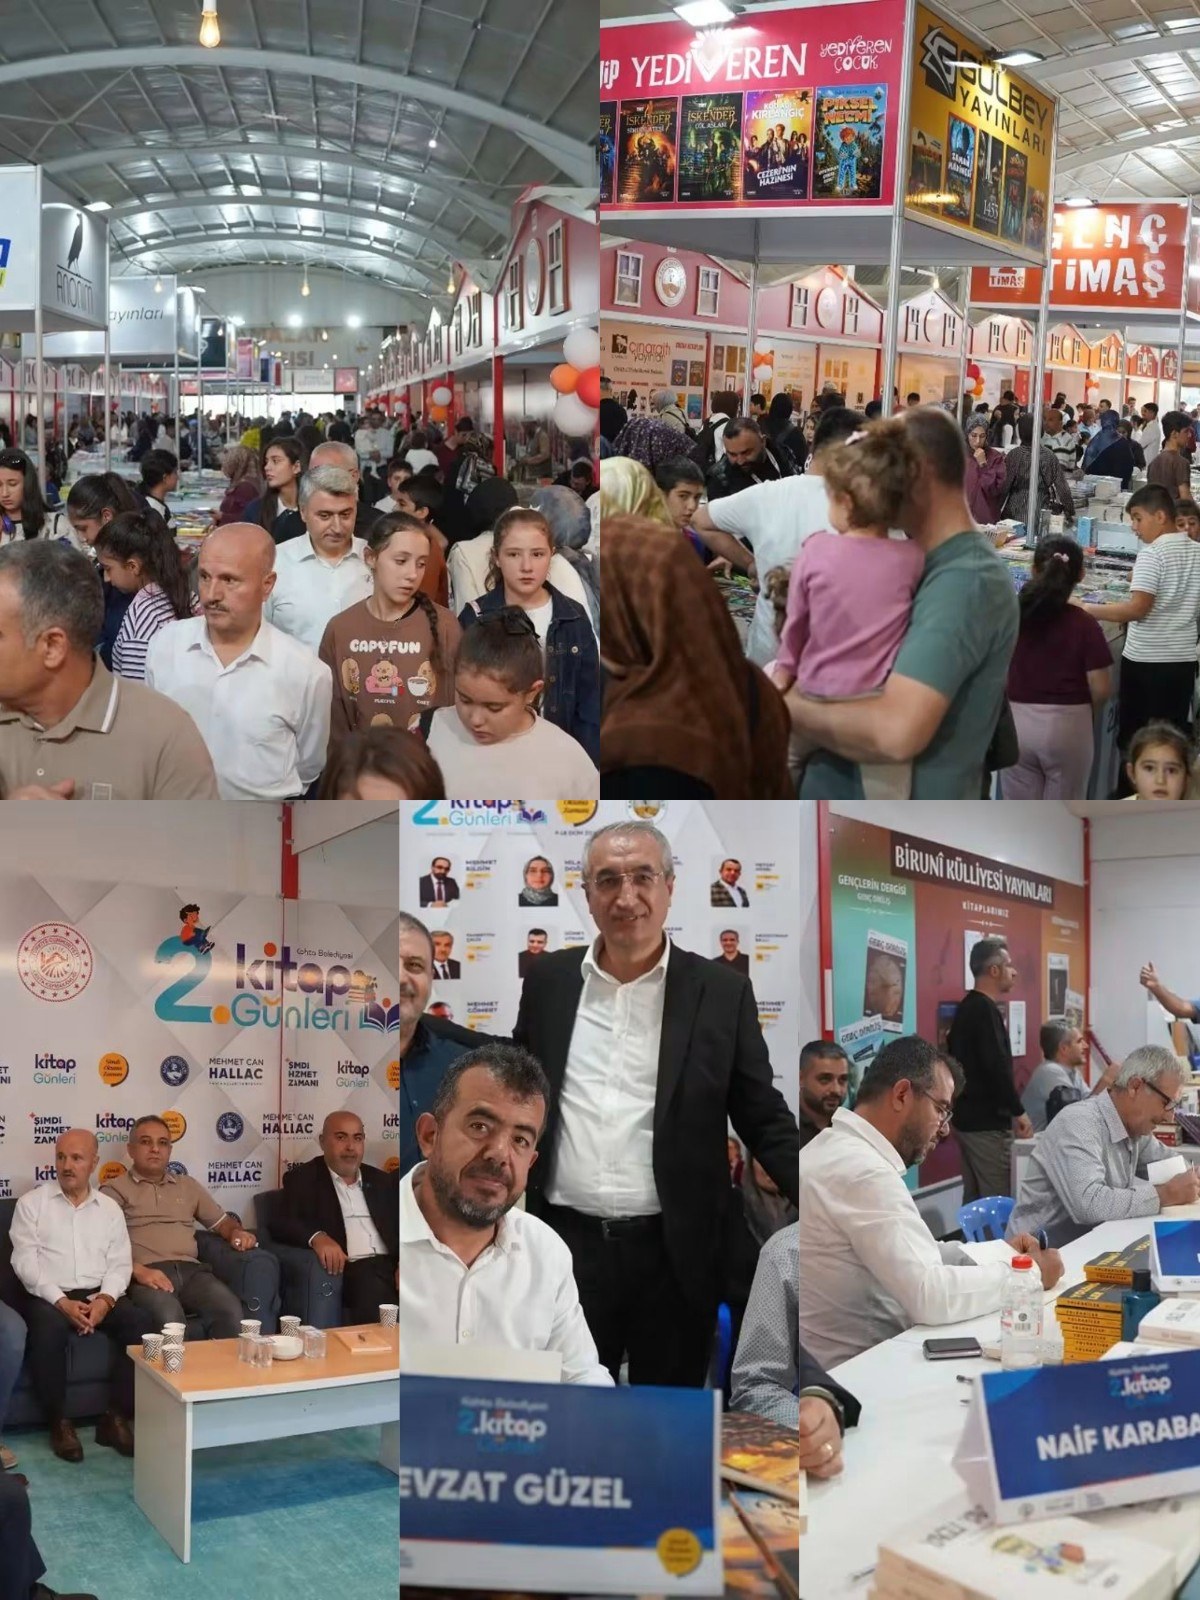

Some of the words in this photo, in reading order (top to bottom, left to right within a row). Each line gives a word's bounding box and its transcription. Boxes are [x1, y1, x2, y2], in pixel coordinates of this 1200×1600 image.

[959, 86, 1046, 155] YAYINLARI
[109, 307, 163, 324] ayınları
[349, 639, 420, 654] CAPYFUN
[895, 843, 945, 878] BİRUNÎ
[946, 857, 1004, 892] KÜLLİYESİ
[1004, 874, 1052, 903] YAYINLARI
[838, 874, 879, 891] GENÇLERİN
[881, 882, 906, 896] DERGİSİ
[236, 943, 351, 1007] kitap
[231, 993, 350, 1032] Günleri
[35, 1053, 76, 1073] kitap
[209, 1057, 244, 1066] MEHMET
[246, 1058, 264, 1066] CAN
[337, 1060, 369, 1078] kitap
[33, 1072, 76, 1084] Günleri
[209, 1067, 263, 1080] HALLAC
[34, 1116, 62, 1125] ŞİMDİ
[96, 1113, 136, 1131] kitap
[297, 1113, 314, 1121] CAN
[383, 1113, 400, 1127] kit
[34, 1136, 56, 1144] ZAM
[96, 1131, 129, 1142] Günle
[35, 1165, 57, 1180] kit
[208, 1161, 242, 1169] MEHMET
[208, 1170, 262, 1182] HALLAC
[1036, 1424, 1098, 1461] NAİF
[1102, 1412, 1200, 1451] KARABA
[400, 1466, 507, 1502] EVZAT
[514, 1467, 632, 1509] GÜZEL
